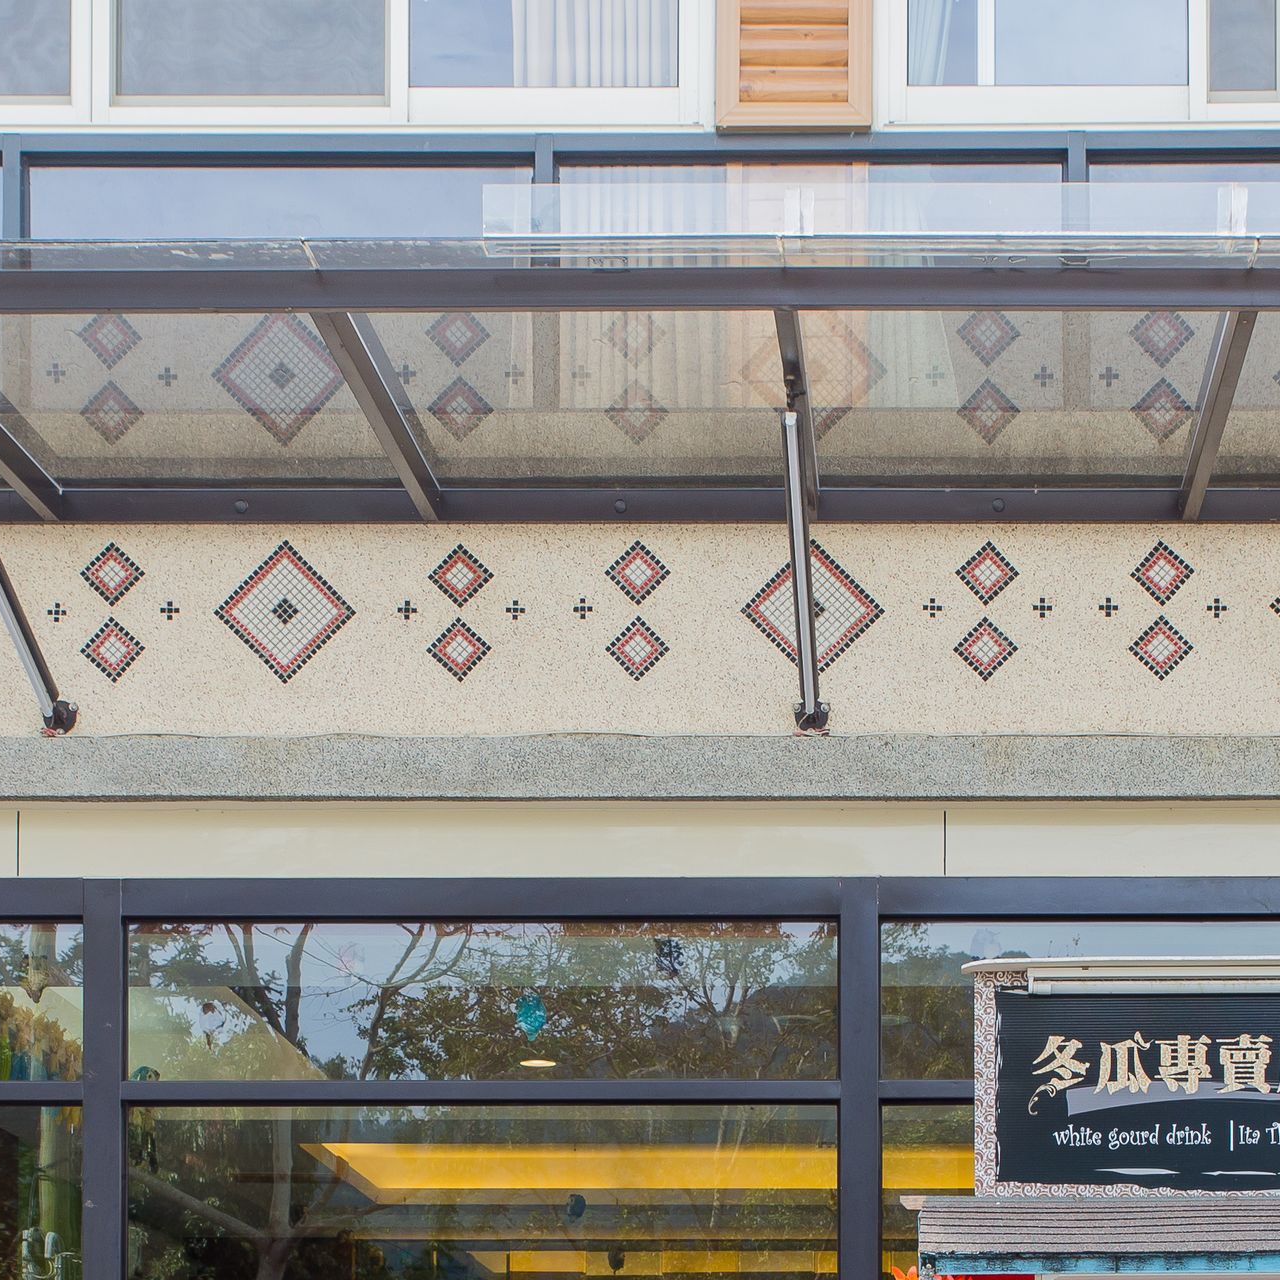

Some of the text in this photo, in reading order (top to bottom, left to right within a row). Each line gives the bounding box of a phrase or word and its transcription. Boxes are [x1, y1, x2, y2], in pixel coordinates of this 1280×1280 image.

[1052, 1124, 1102, 1147] white
[1108, 1123, 1160, 1151] gourd
[1166, 1123, 1212, 1146] drink
